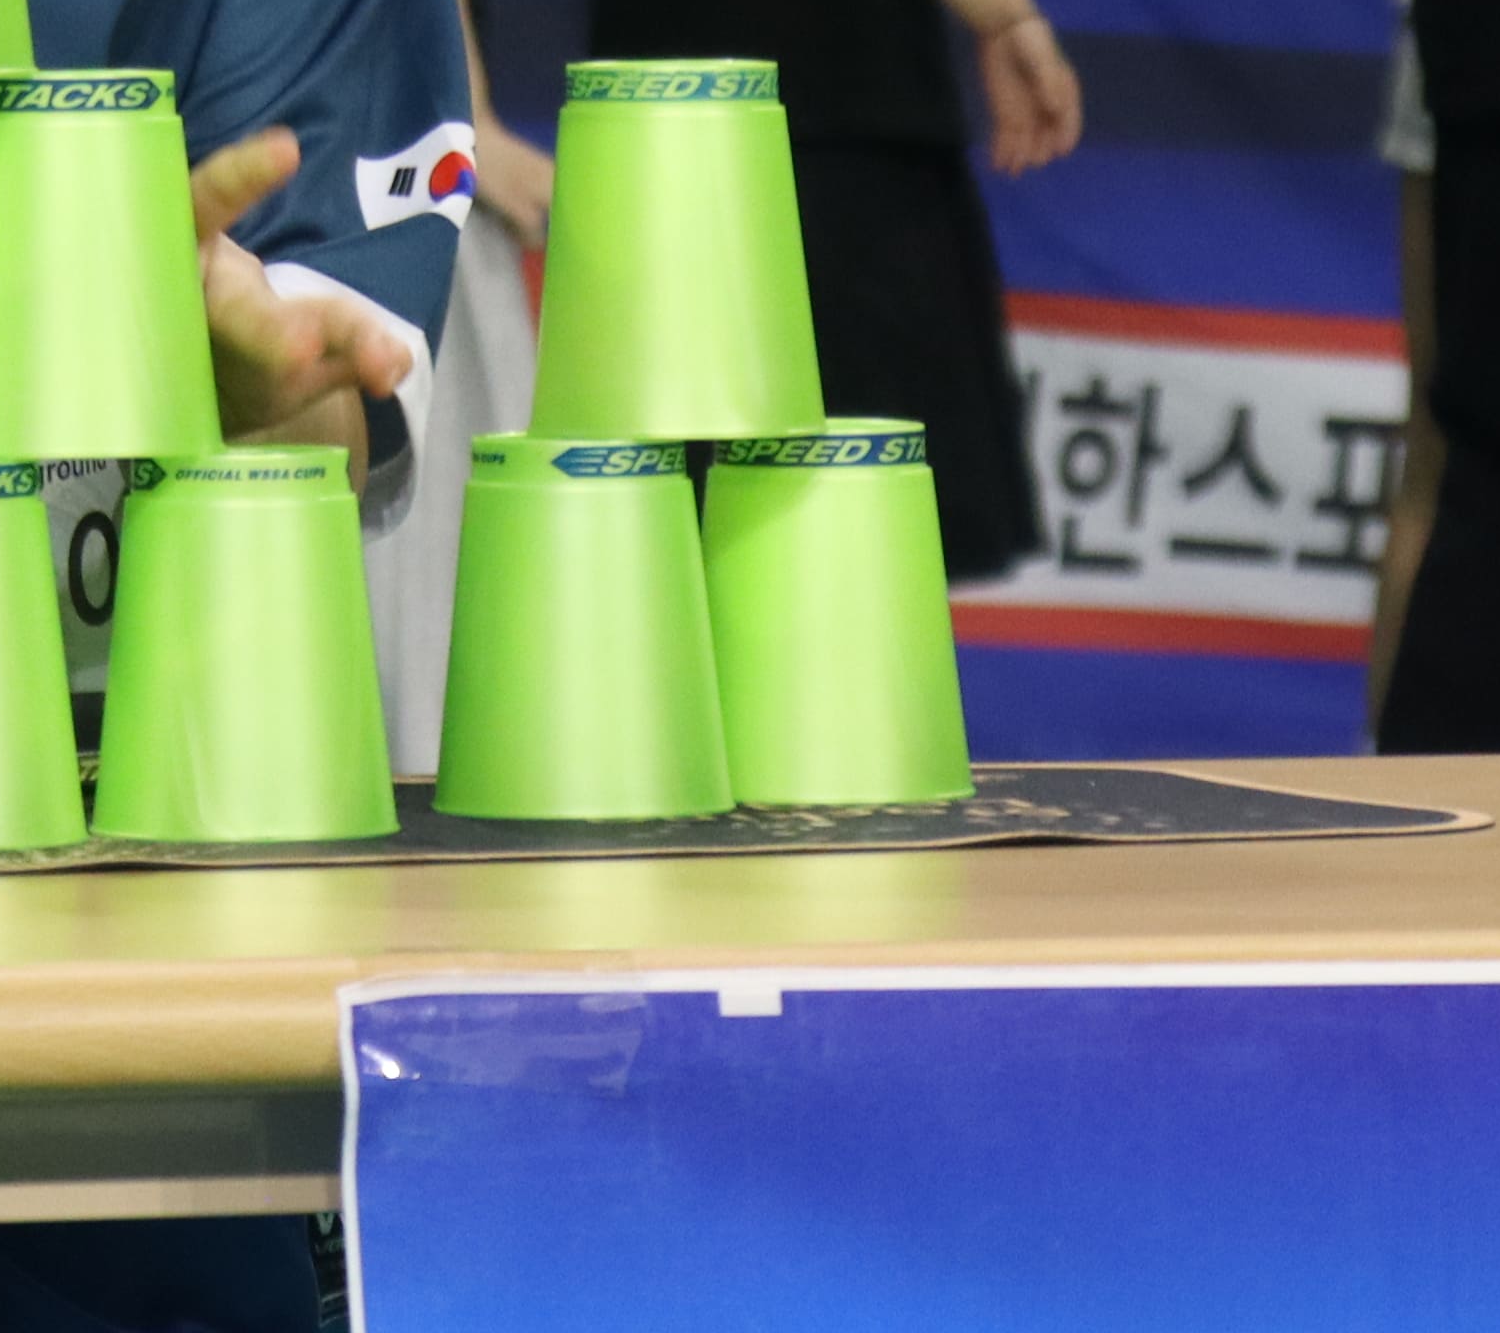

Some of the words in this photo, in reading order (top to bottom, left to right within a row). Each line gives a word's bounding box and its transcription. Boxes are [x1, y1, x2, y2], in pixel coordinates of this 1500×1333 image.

[571, 72, 701, 99] SPEED
[709, 71, 778, 97] STA
[727, 439, 872, 465] SPEED
[174, 469, 243, 481] OFFICIAL
[1022, 369, 1406, 575] 한스포
